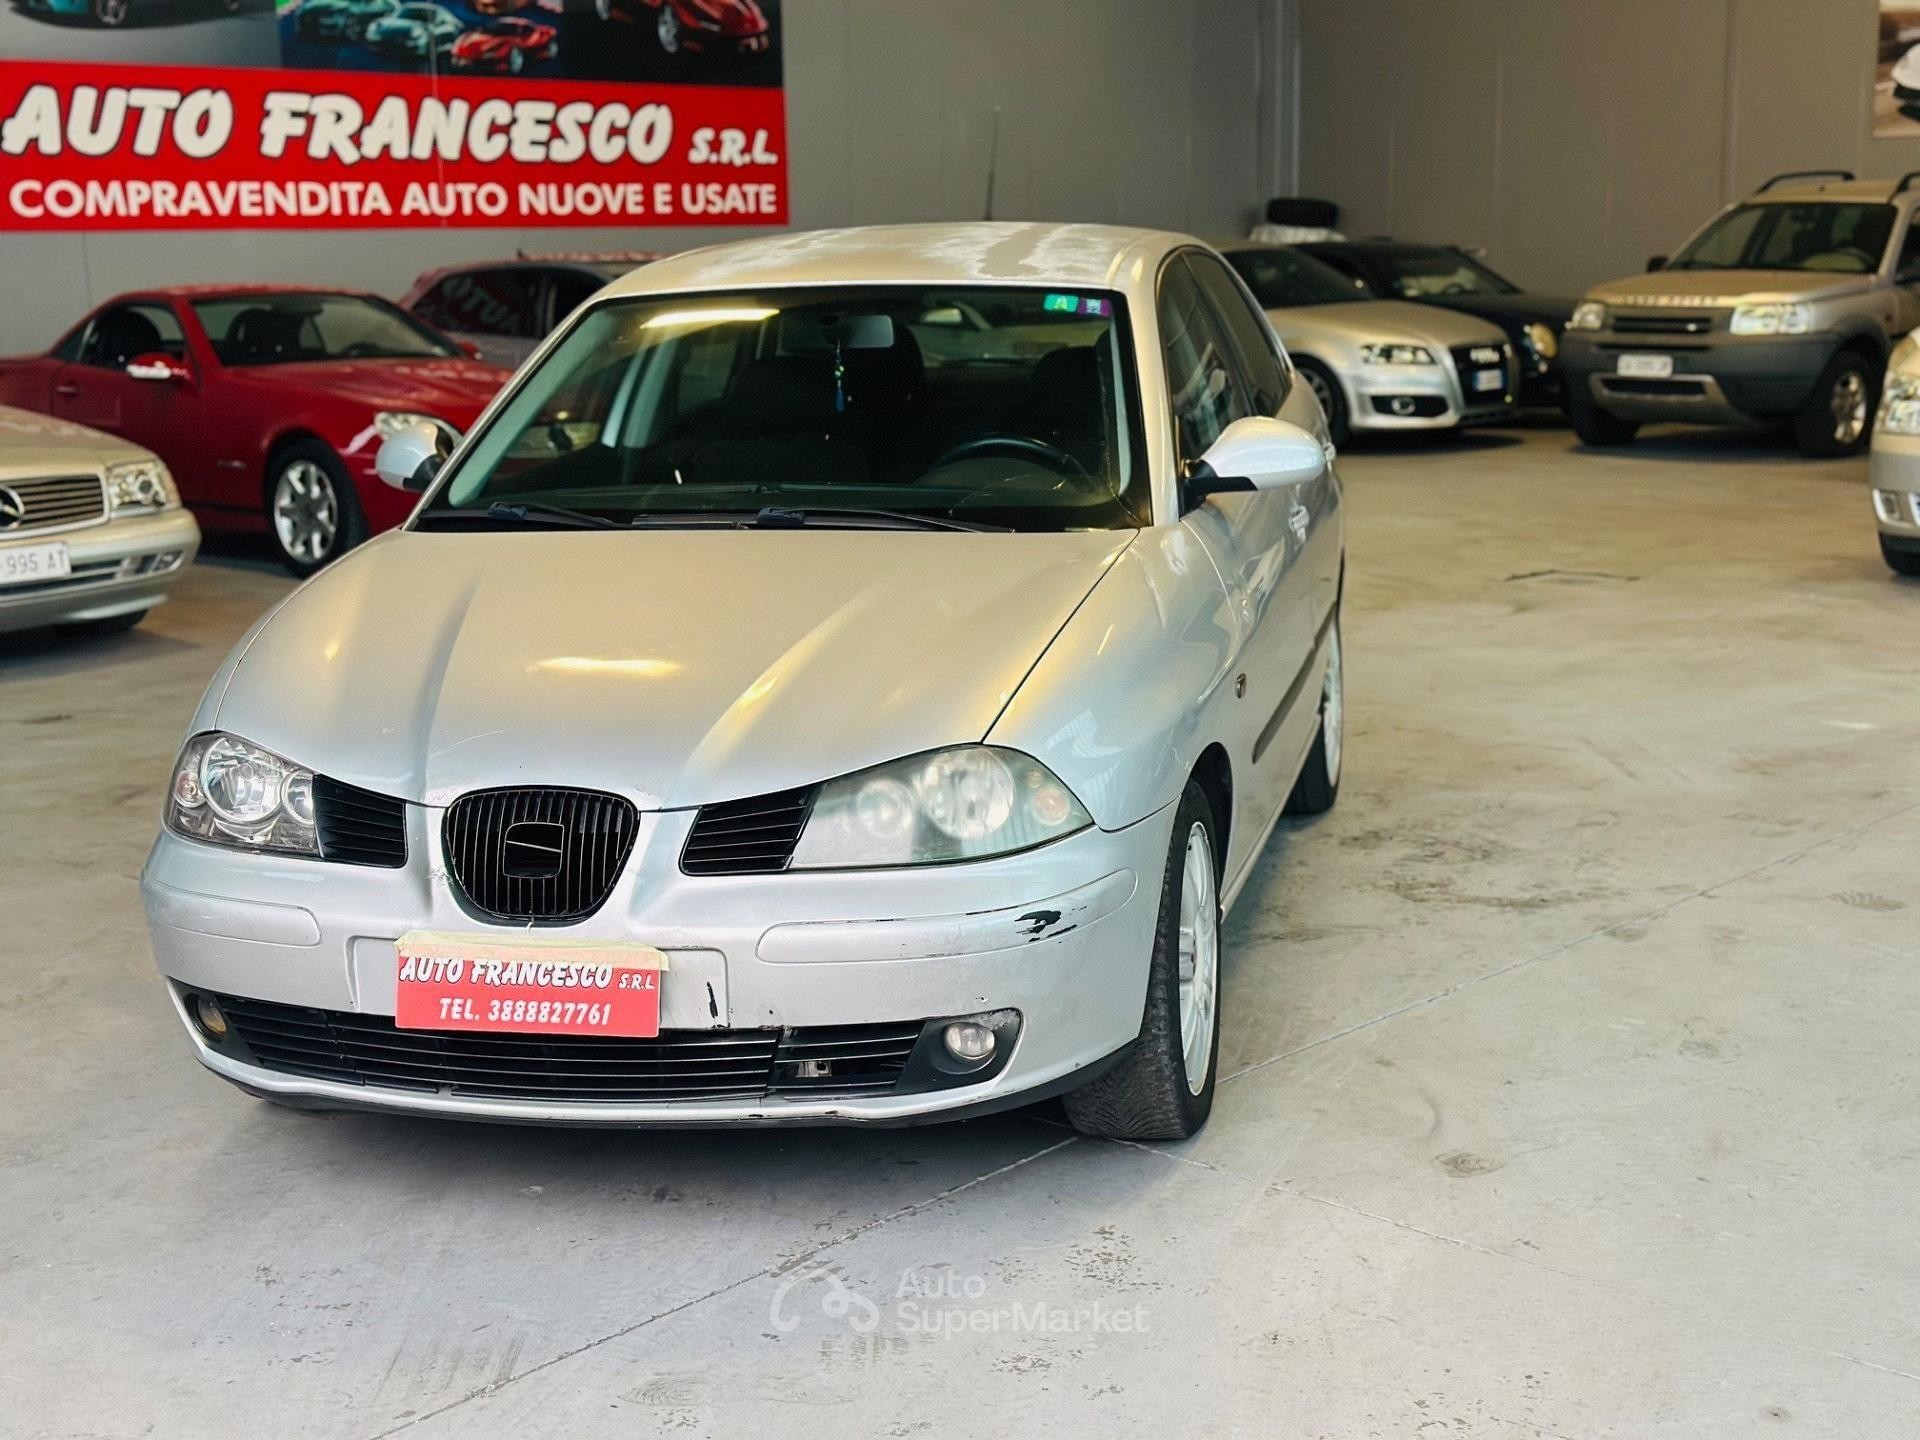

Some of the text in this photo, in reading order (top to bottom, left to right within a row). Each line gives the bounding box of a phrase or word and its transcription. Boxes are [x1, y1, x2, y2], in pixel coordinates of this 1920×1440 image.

[2, 84, 233, 157] AUTO
[258, 93, 674, 165] FRANCESCO
[10, 180, 776, 218] COMPRAVENDITA AUTO NUOVE E USATE
[6, 553, 39, 574] 995
[400, 957, 464, 983] AUTO
[471, 959, 612, 988] FRANCESCO
[440, 998, 611, 1026] TEL. 3888827761
